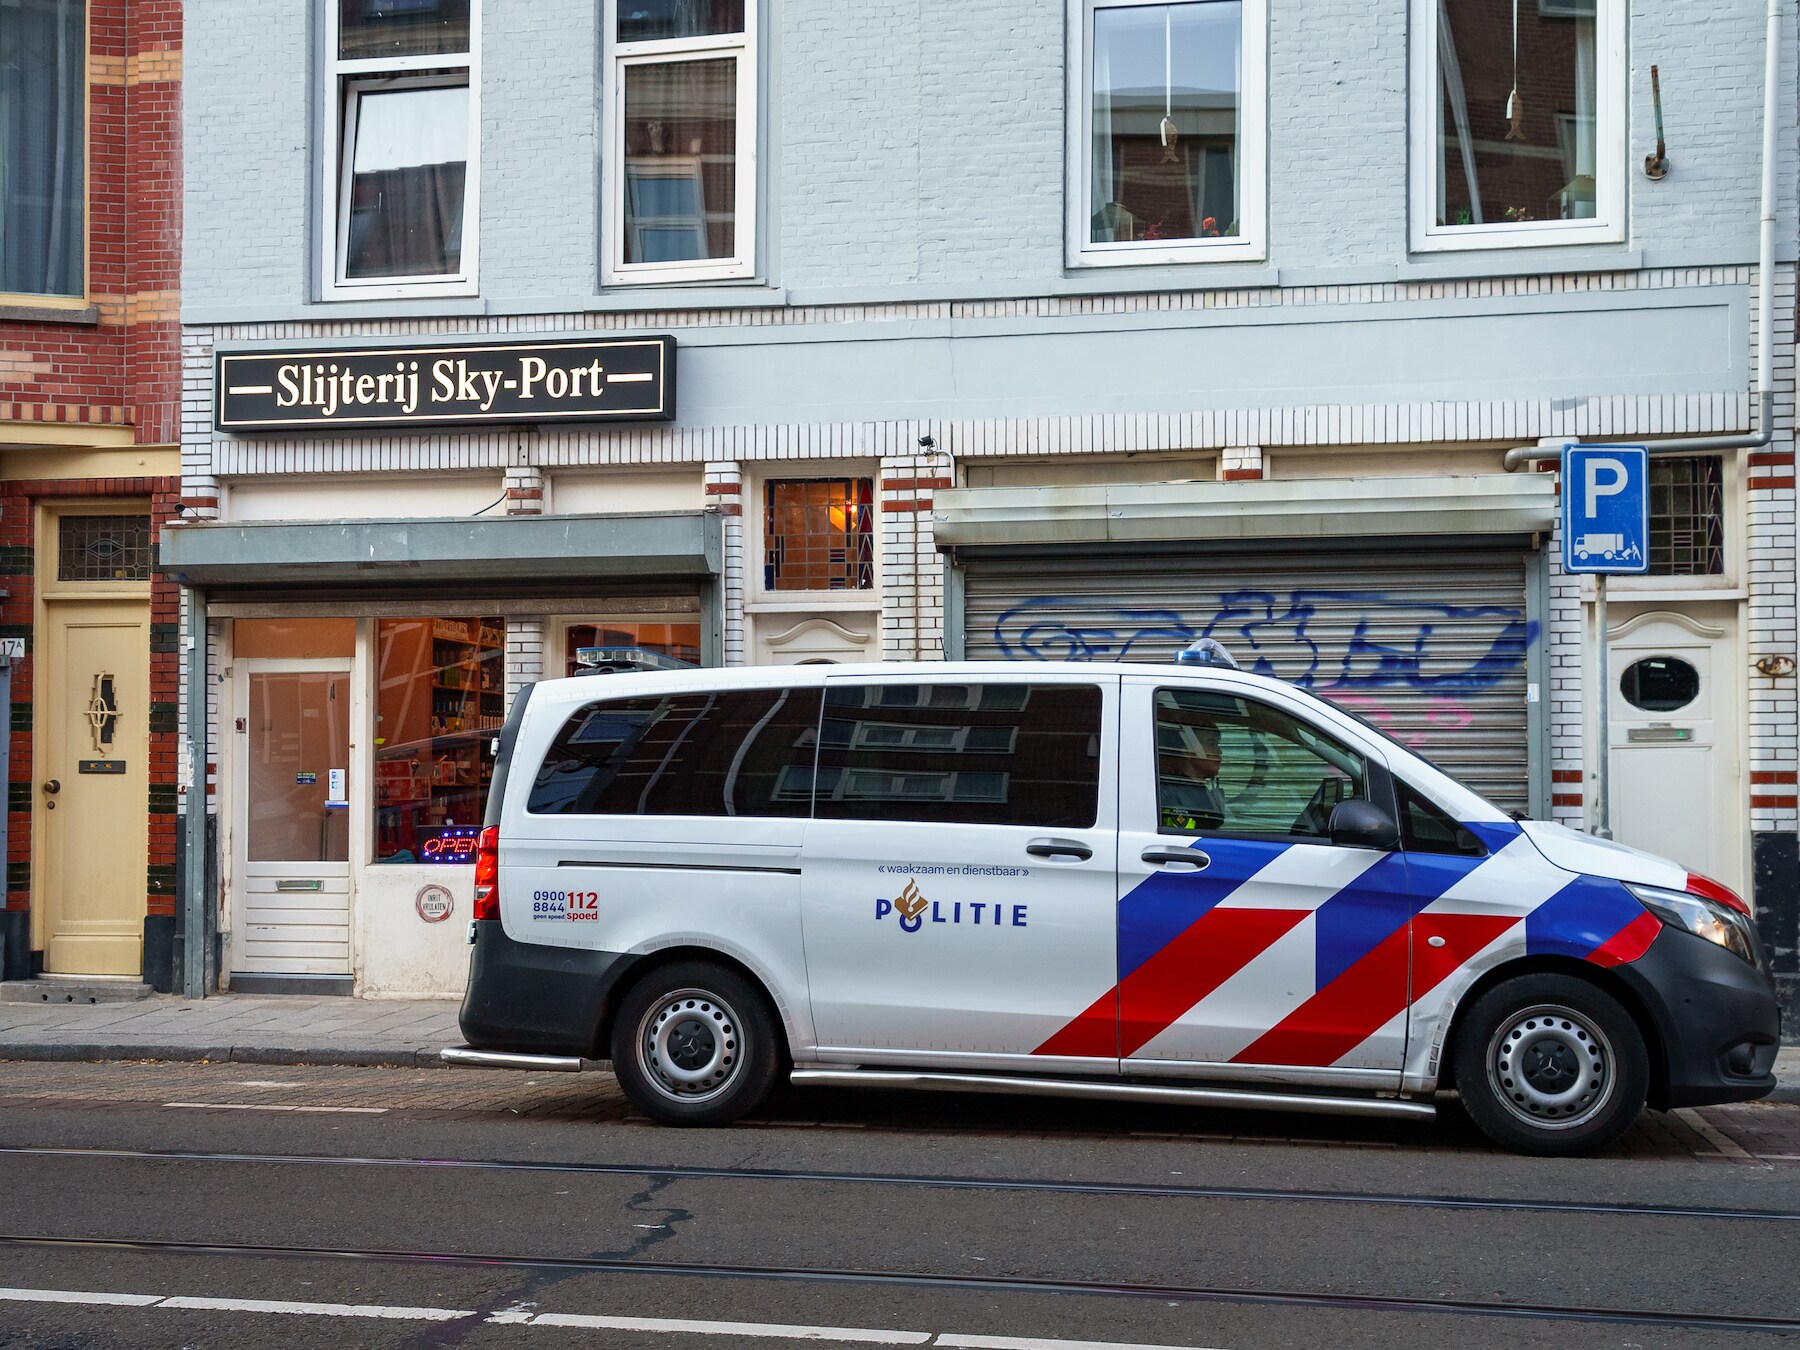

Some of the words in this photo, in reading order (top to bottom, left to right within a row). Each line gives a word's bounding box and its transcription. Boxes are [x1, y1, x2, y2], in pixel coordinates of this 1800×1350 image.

[277, 361, 418, 416] Slijterij
[432, 357, 604, 411] Sky-Port
[1585, 458, 1629, 518] P
[887, 863, 944, 875] waakzaam
[947, 866, 960, 875] en
[962, 865, 1021, 877] dienstbaar
[533, 890, 565, 901] 0900
[567, 891, 598, 909] 112
[533, 902, 565, 912] 8844
[566, 911, 598, 922] spoed
